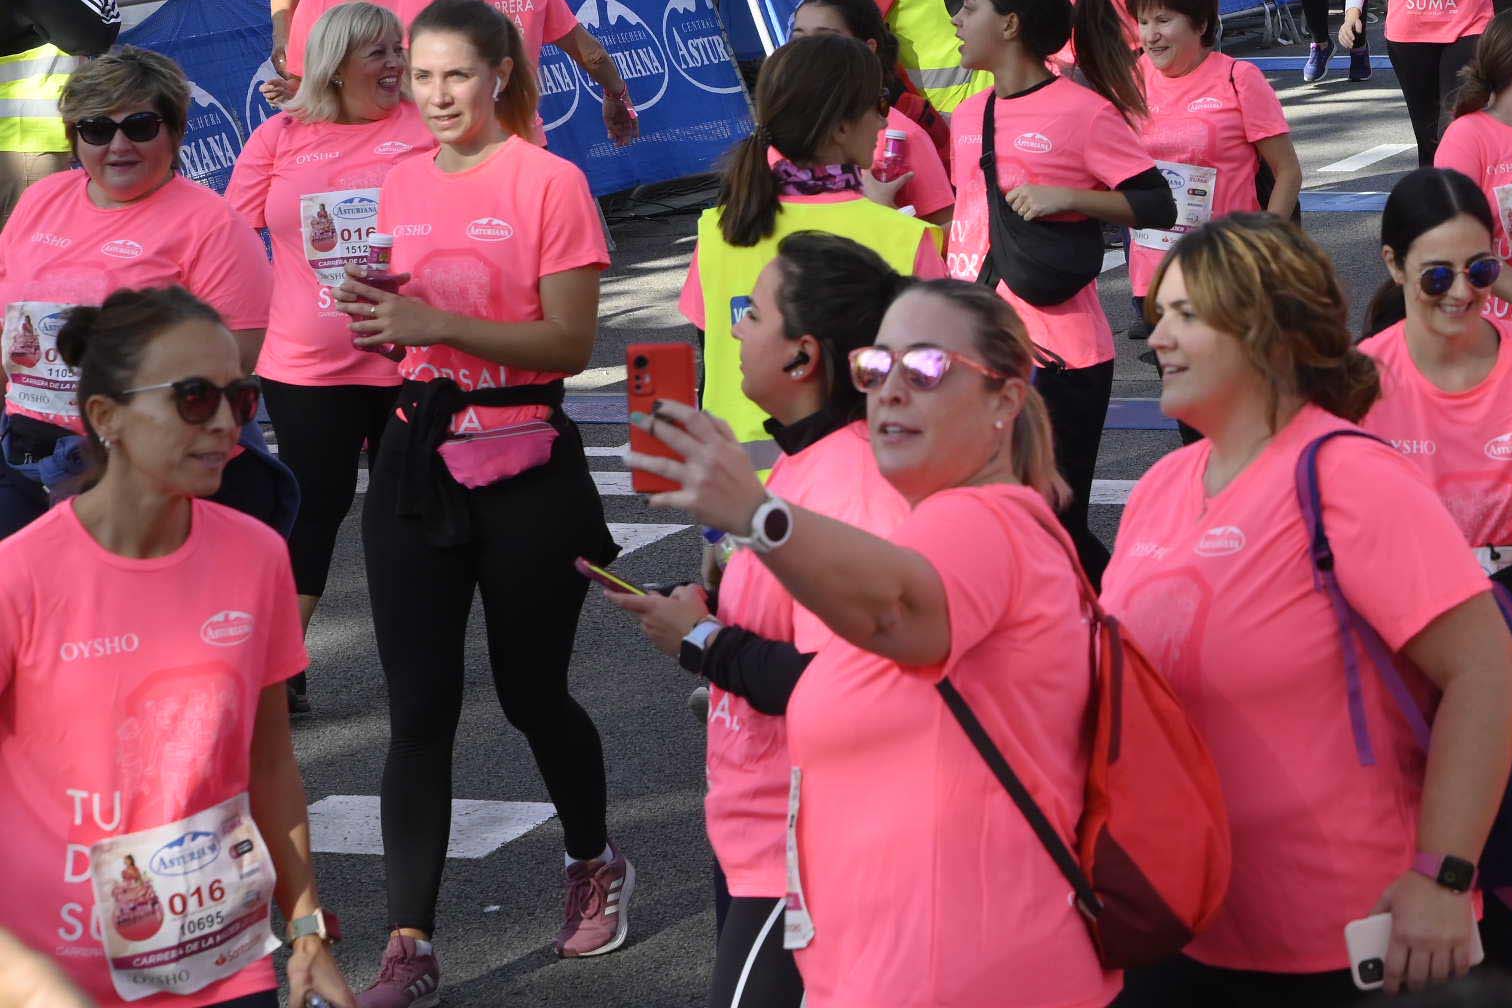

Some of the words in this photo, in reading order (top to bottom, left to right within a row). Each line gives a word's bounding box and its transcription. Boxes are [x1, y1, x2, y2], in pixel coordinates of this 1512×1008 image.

[676, 27, 730, 70] ASTUR
[179, 132, 236, 176] RIANA
[340, 226, 376, 242] 016
[1390, 439, 1436, 455] YSHO
[61, 631, 140, 662] OYSHO
[66, 787, 123, 832] TU
[169, 879, 225, 916] 016
[179, 911, 225, 936] 10695
